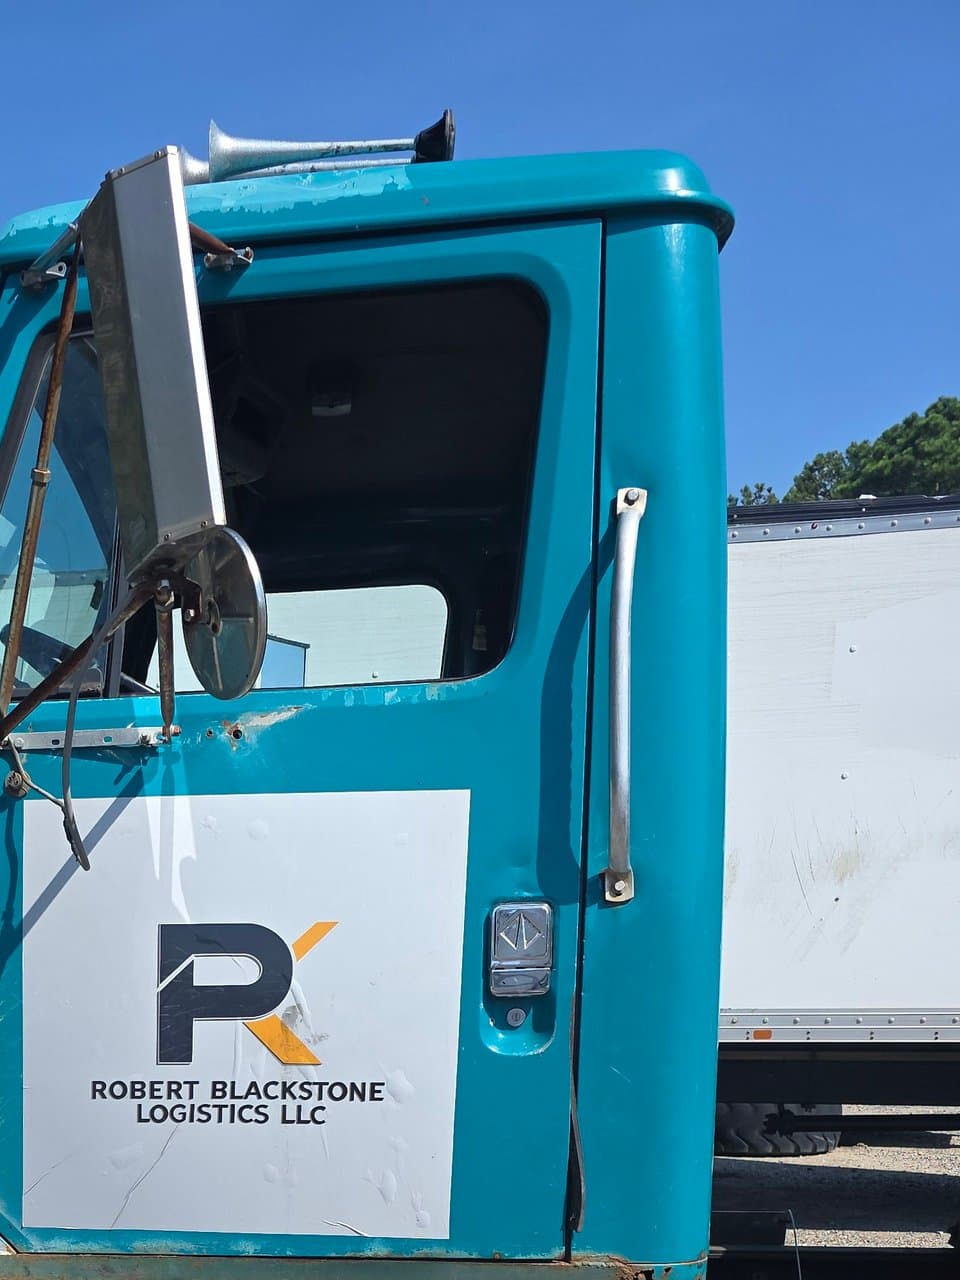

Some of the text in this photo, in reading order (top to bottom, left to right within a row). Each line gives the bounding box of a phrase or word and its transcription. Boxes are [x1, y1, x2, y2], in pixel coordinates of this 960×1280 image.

[91, 1080, 385, 1102] ROBERT BLACKSTONE
[136, 1103, 326, 1125] LOGISTICS LLC
